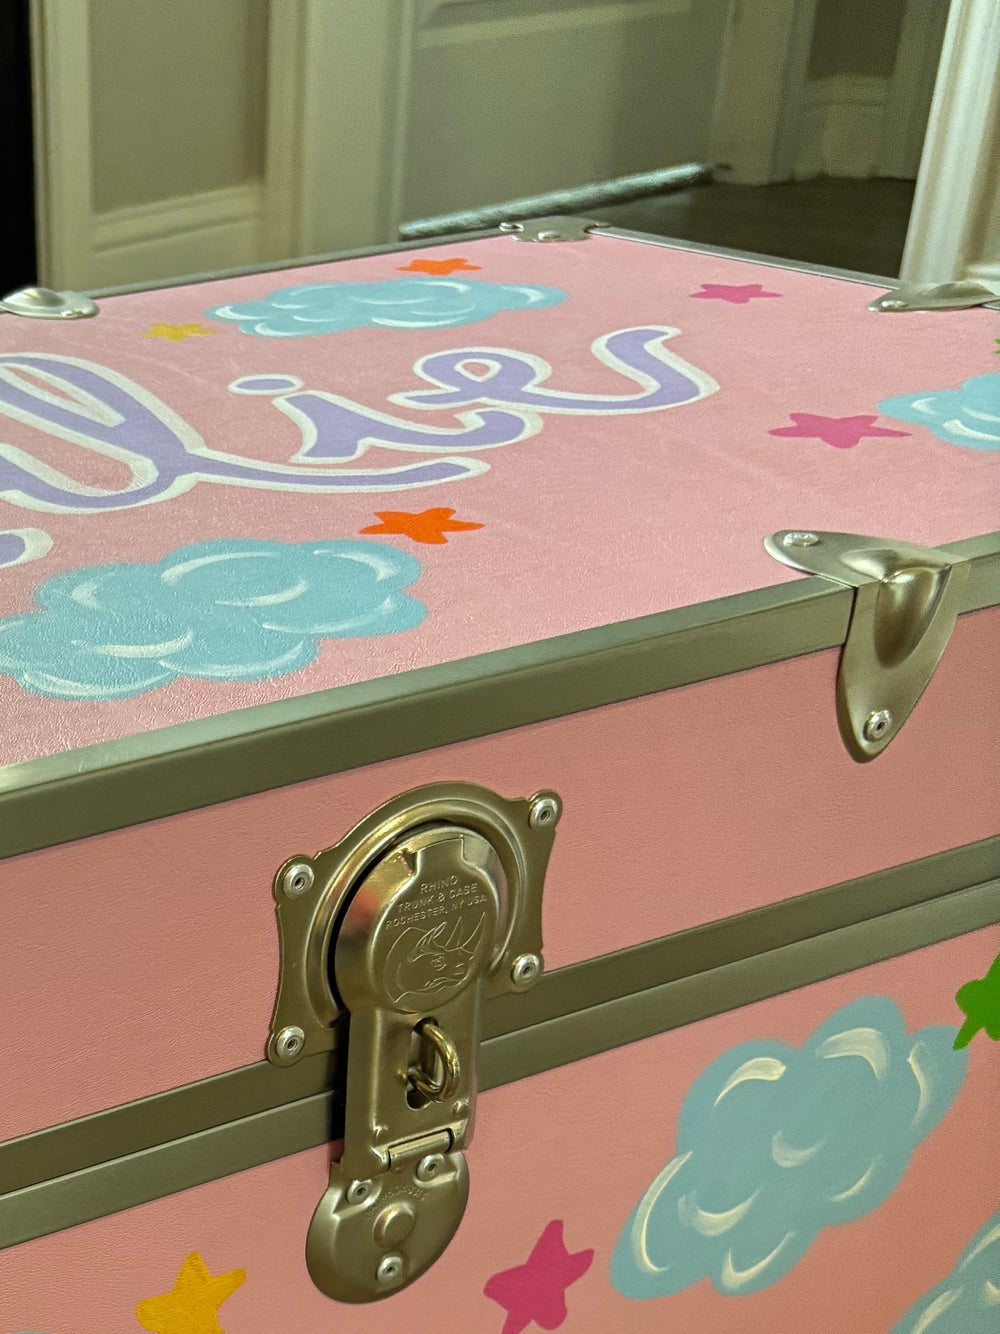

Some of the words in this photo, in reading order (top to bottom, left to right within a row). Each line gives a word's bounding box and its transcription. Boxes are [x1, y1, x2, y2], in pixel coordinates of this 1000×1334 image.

[420, 875, 458, 894] RHINO
[398, 895, 434, 913] TRUNK
[438, 892, 446, 902] &
[450, 883, 478, 899] CASE
[451, 900, 465, 912] NY
[468, 895, 487, 907] USA
